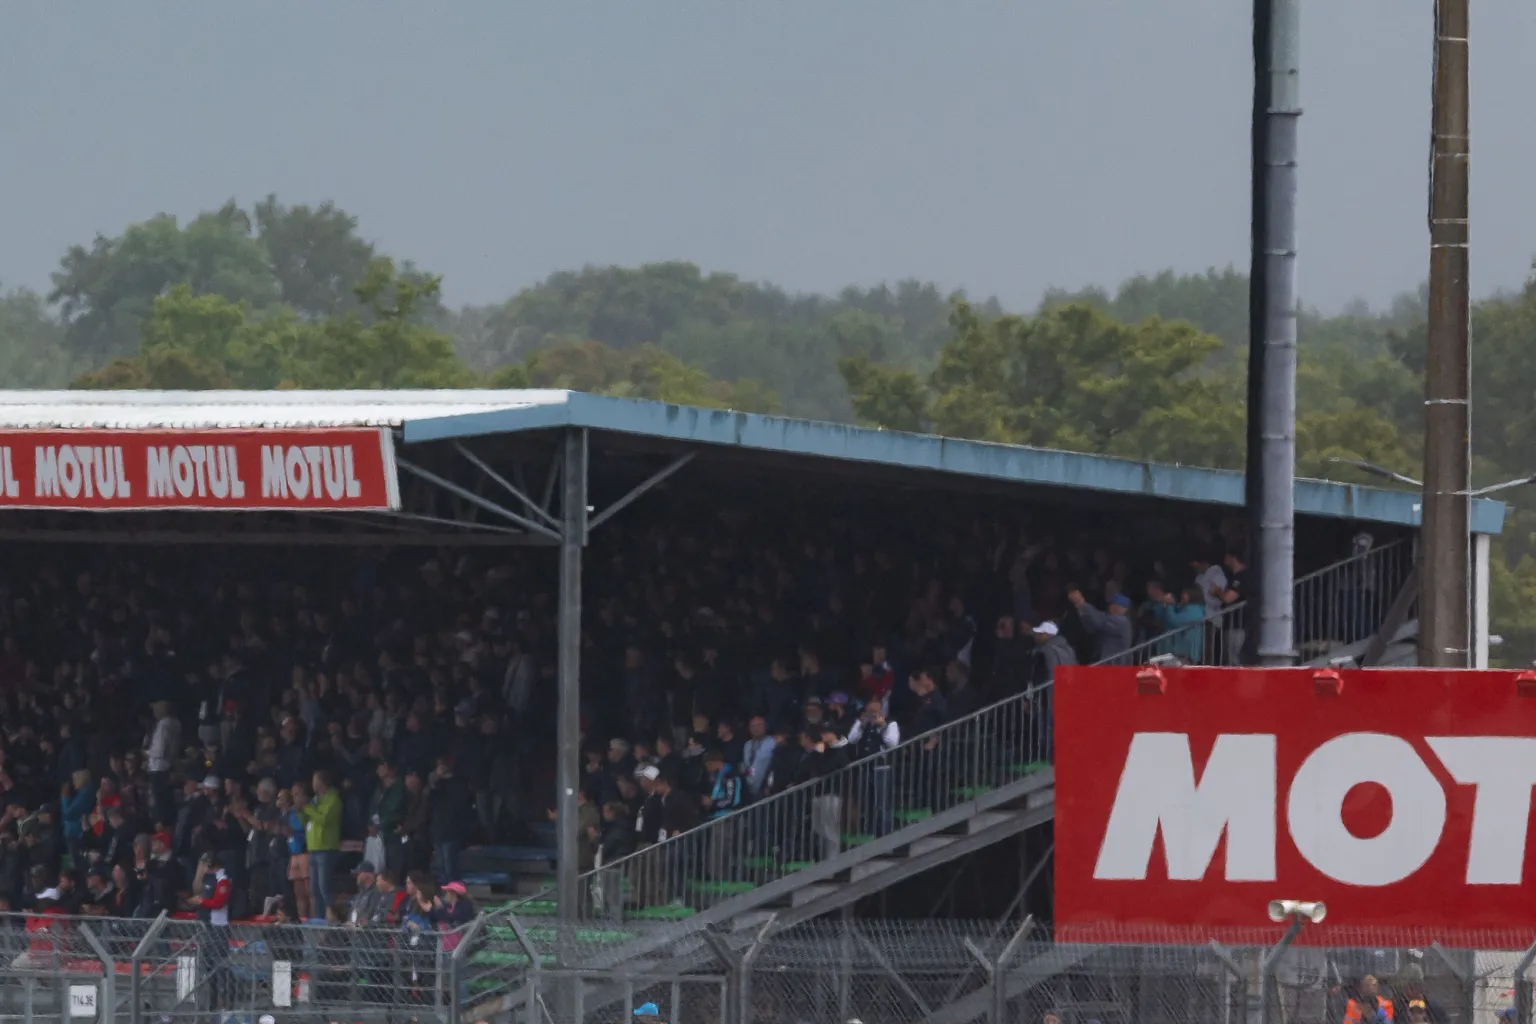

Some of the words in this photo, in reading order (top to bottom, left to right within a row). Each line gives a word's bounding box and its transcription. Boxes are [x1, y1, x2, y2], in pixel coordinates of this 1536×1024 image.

[34, 445, 131, 500] MOTUL
[147, 446, 245, 500] MOTUL
[263, 445, 361, 500] MOTUL
